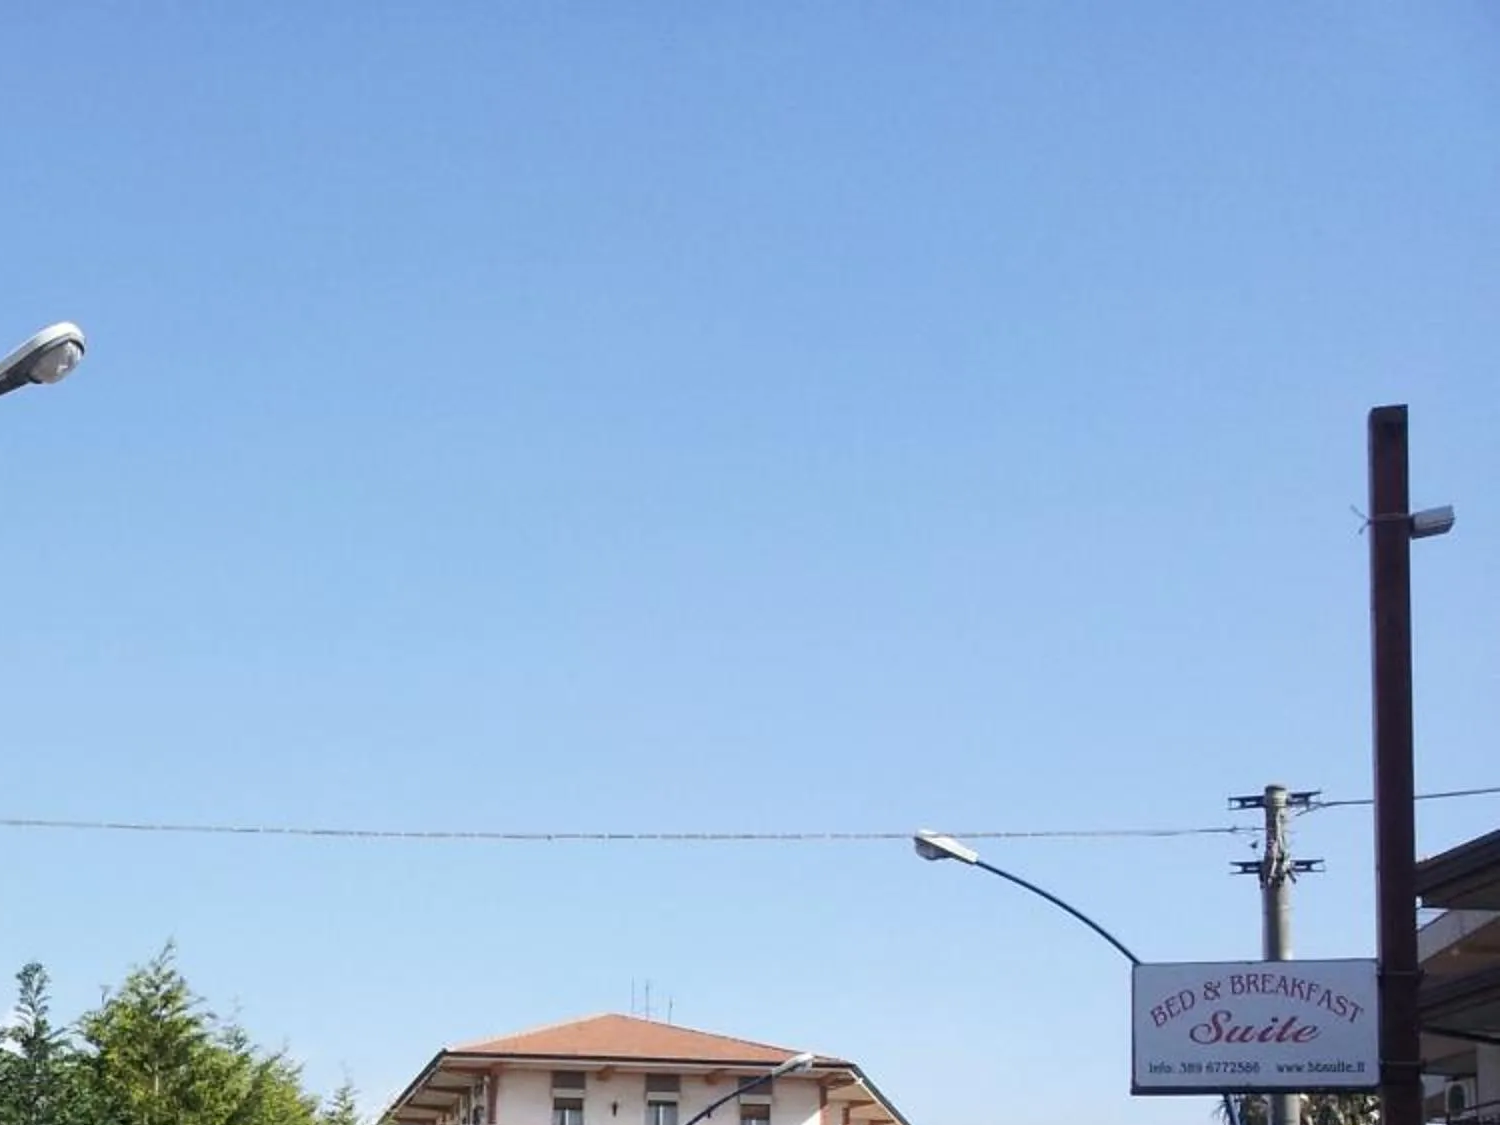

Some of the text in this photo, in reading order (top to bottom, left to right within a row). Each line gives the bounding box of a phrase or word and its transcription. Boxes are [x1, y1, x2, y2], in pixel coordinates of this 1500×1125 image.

[1150, 973, 1364, 1028] BED & BREAKFAST
[1189, 1009, 1321, 1045] Suite
